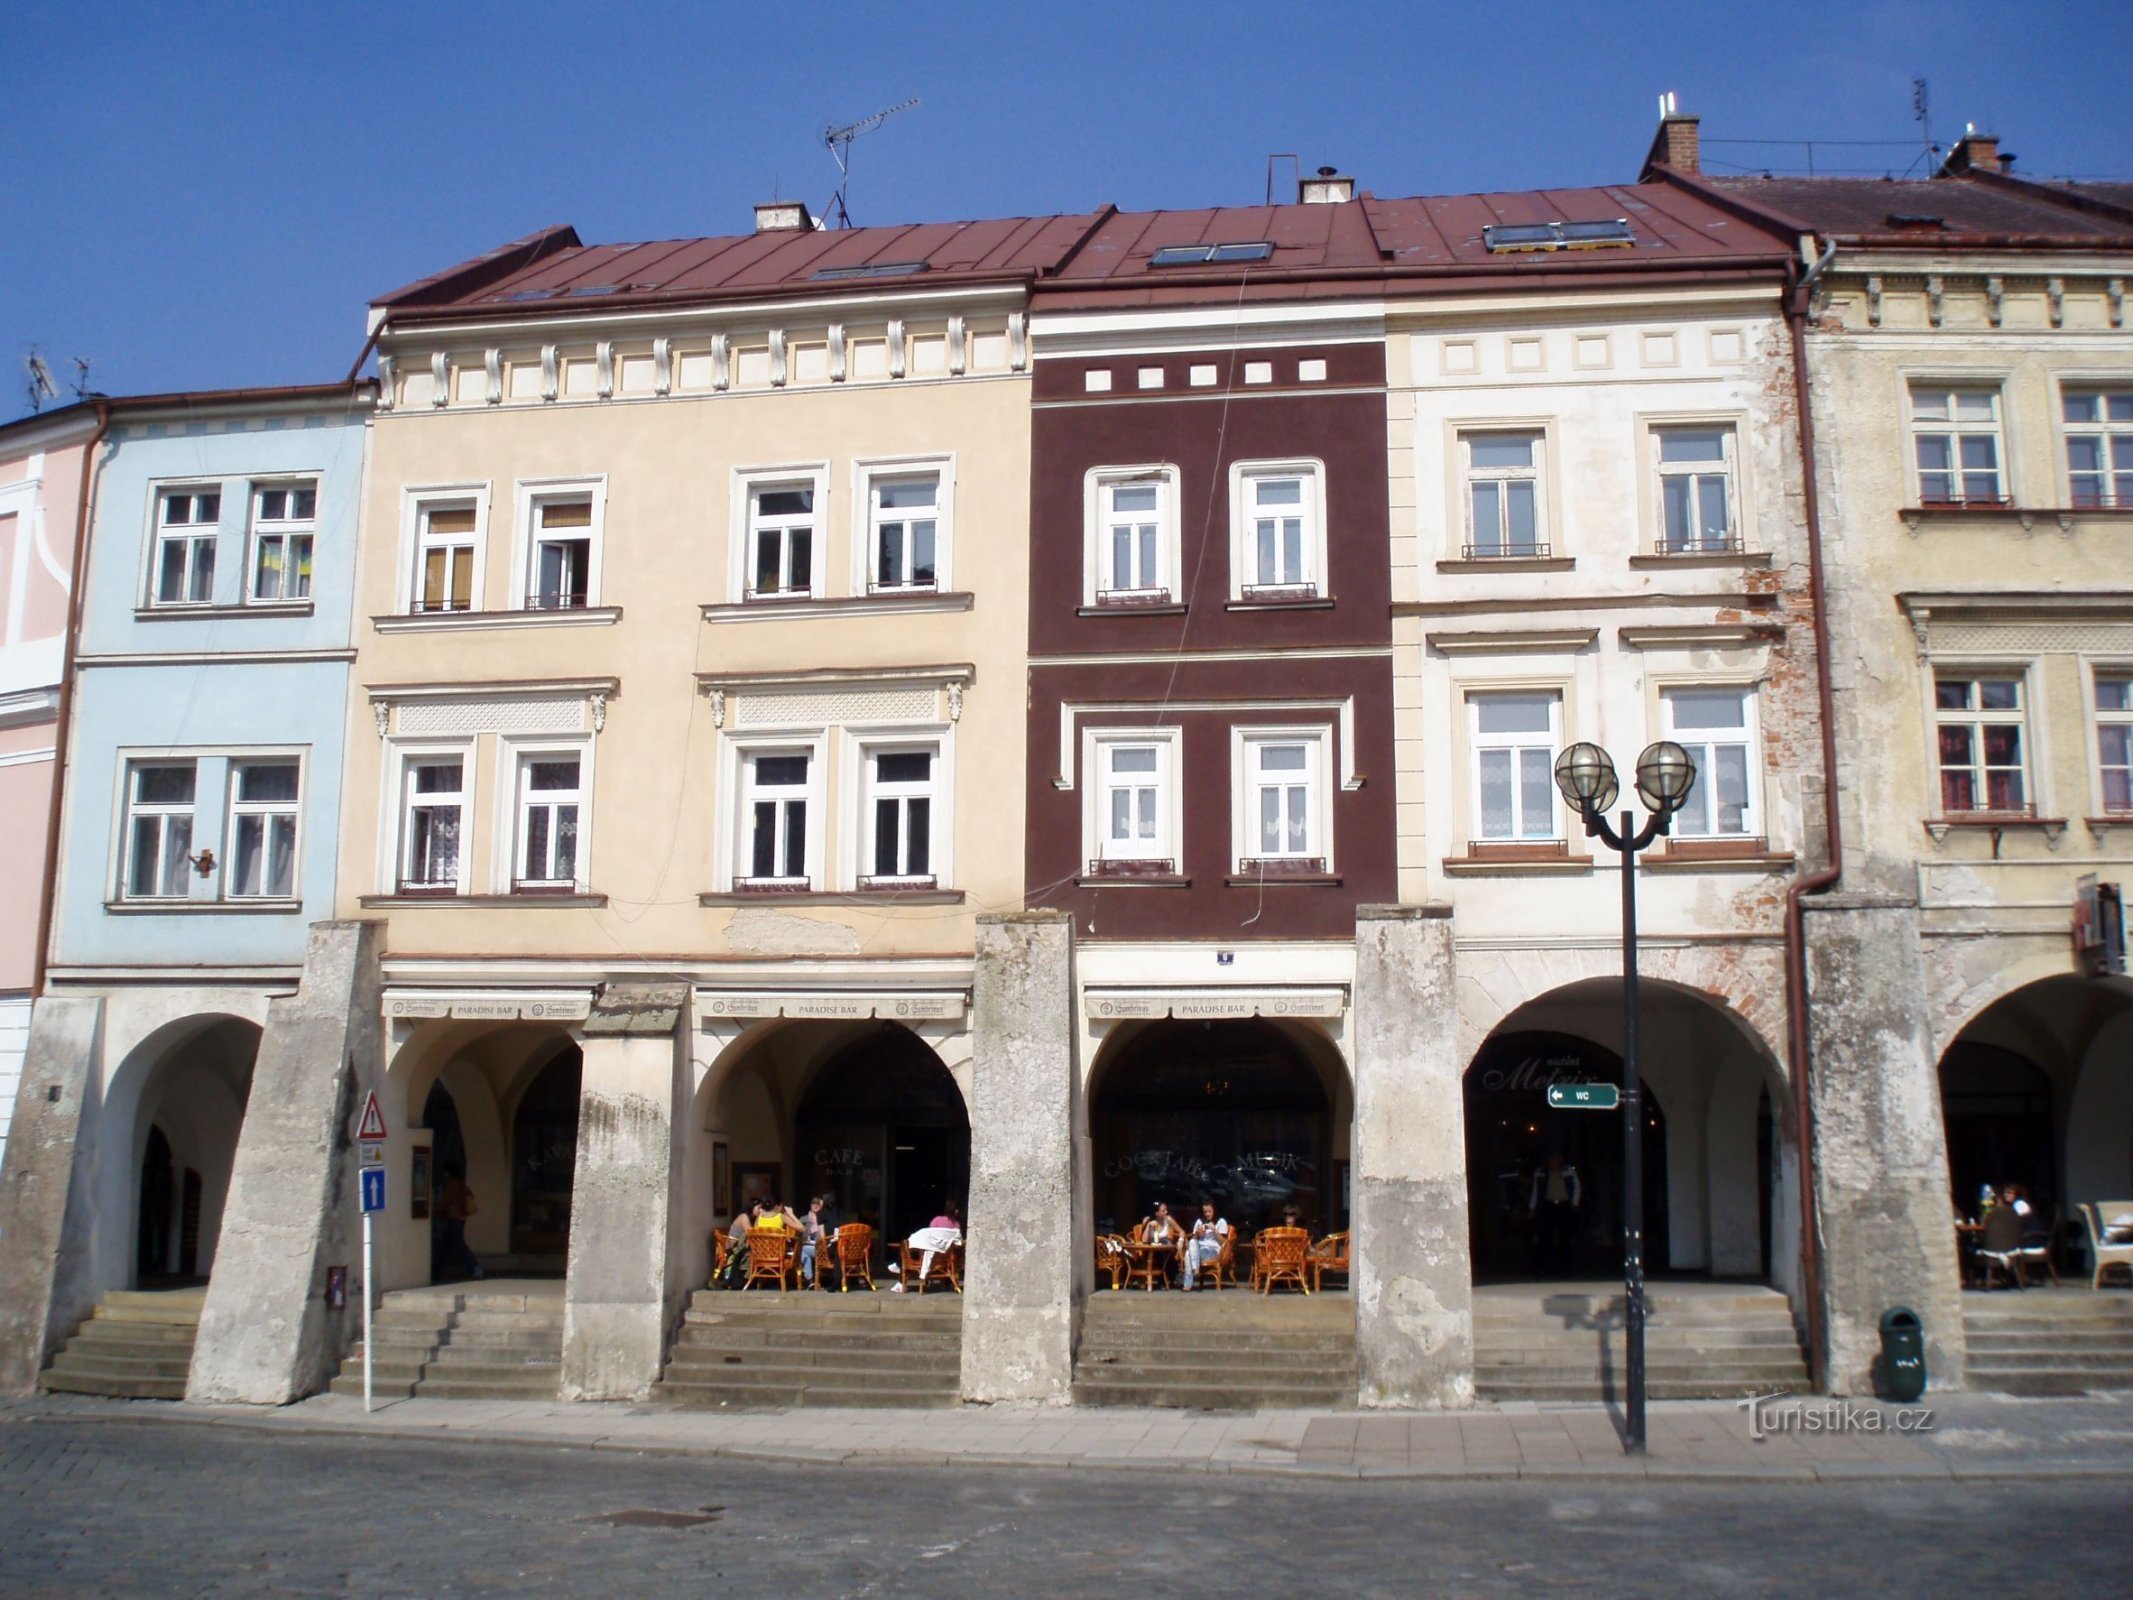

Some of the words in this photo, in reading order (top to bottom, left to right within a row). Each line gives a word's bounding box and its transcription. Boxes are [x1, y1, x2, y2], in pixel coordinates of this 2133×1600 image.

[457, 1006, 494, 1014] PARADISE
[497, 1006, 512, 1014] BAR
[799, 1006, 837, 1015] PARADISE
[840, 1006, 857, 1015] BAR
[1182, 1005, 1223, 1014] PARADISE
[1227, 1005, 1245, 1014] BAR
[1576, 1091, 1589, 1101] WC
